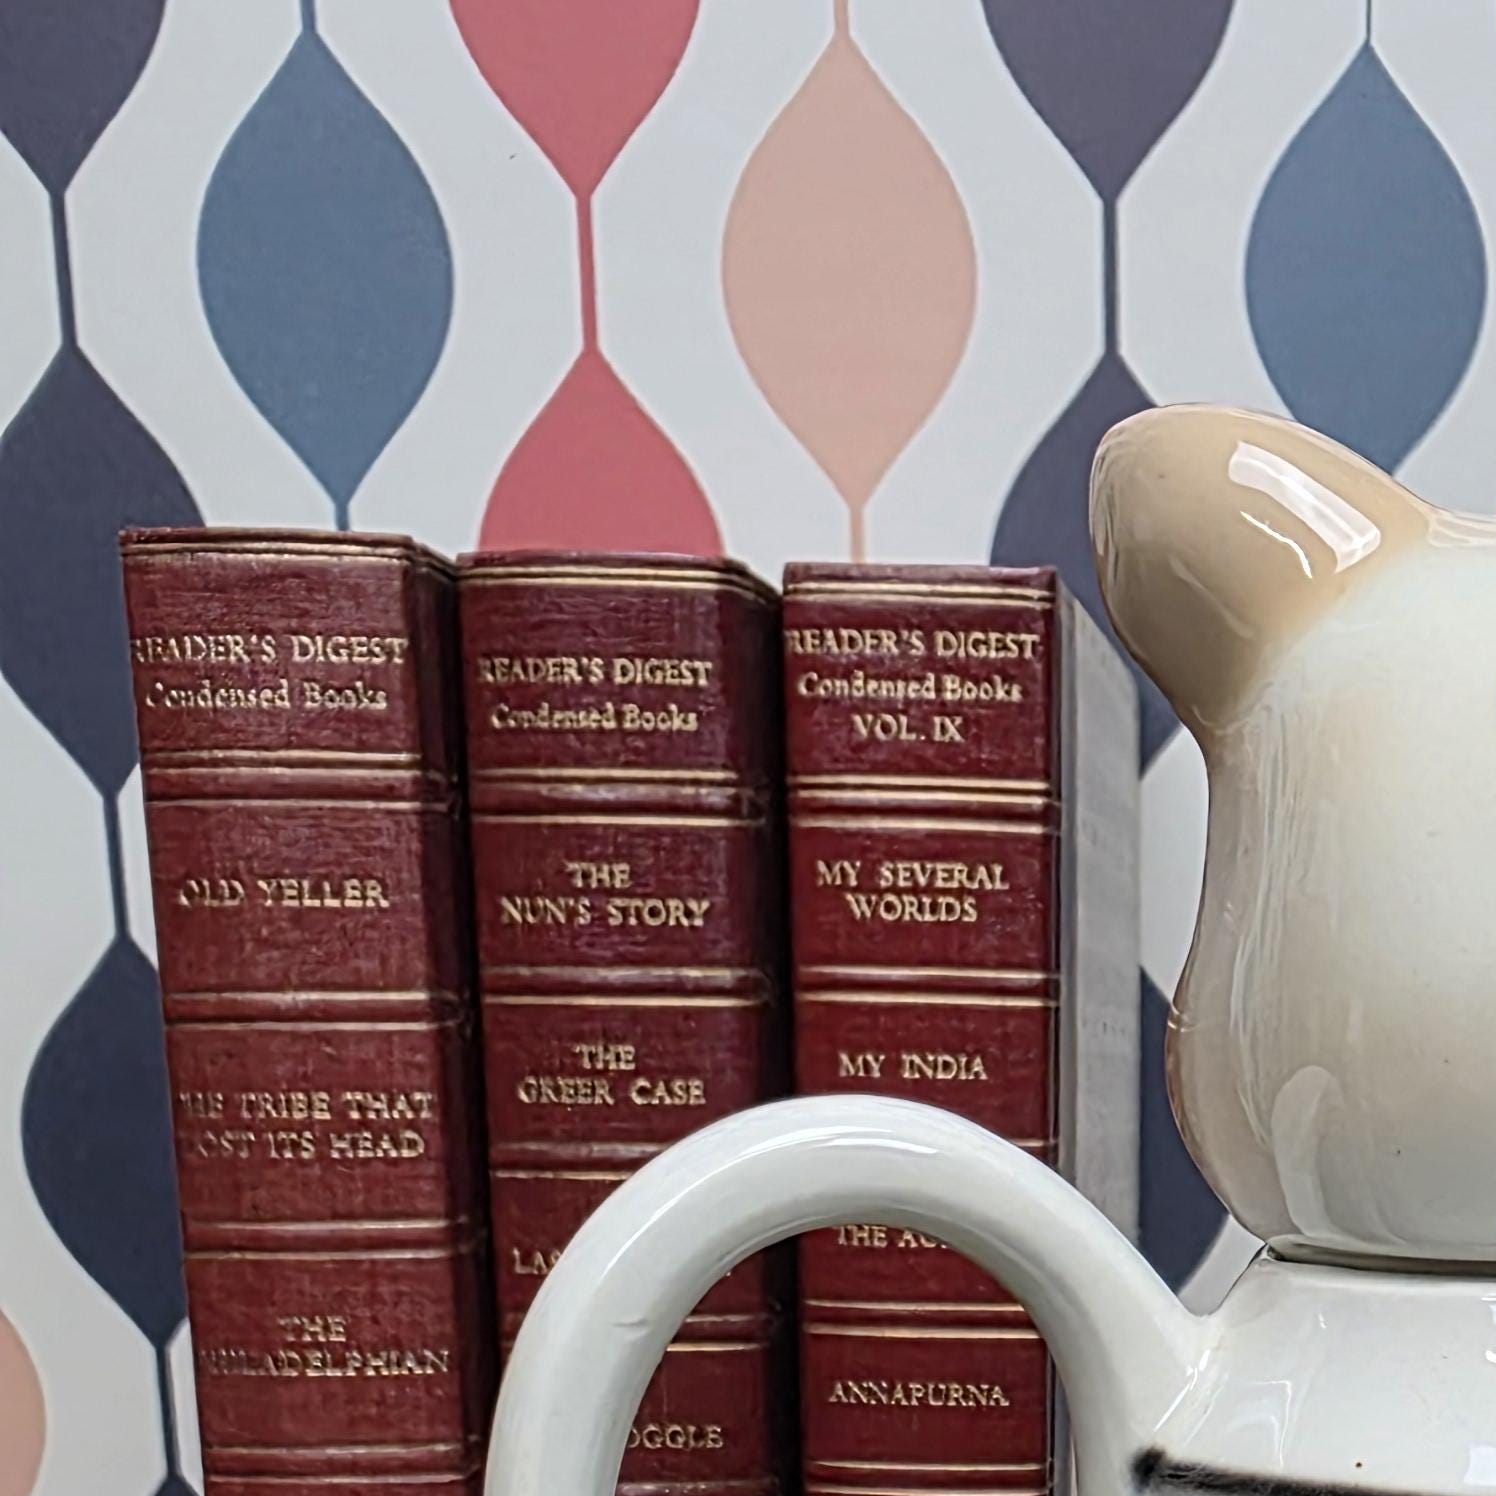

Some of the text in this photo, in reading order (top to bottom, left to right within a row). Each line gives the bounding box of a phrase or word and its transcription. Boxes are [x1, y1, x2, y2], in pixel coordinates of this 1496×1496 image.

[290, 635, 409, 665] DIGEST
[785, 629, 1041, 659] READER'S DIGEST
[477, 656, 713, 686] READER'S DIGEST
[798, 669, 1023, 703] Condensed Books
[145, 679, 388, 711] Condensed Books
[490, 702, 699, 732] Condensed Books
[851, 713, 965, 742] VOL. IX
[565, 861, 632, 889] THE
[815, 860, 1010, 890] MY SEVERAL
[178, 878, 391, 908] OLD YELLER
[845, 893, 978, 922] WORLDS
[499, 896, 712, 927] NUN'S STORY
[574, 1044, 636, 1071] THE
[837, 1051, 989, 1081] MY INDIA
[238, 1090, 332, 1120] TRIBE
[343, 1090, 436, 1120] THAT
[517, 1075, 707, 1105] GREER CASE
[267, 1130, 317, 1160] ITS
[329, 1131, 425, 1159] HEAD
[838, 1224, 889, 1248] THE
[276, 1314, 350, 1342] THE
[200, 1346, 449, 1377] LADELPHIAN
[828, 1380, 1010, 1408] ANNAPURNA
